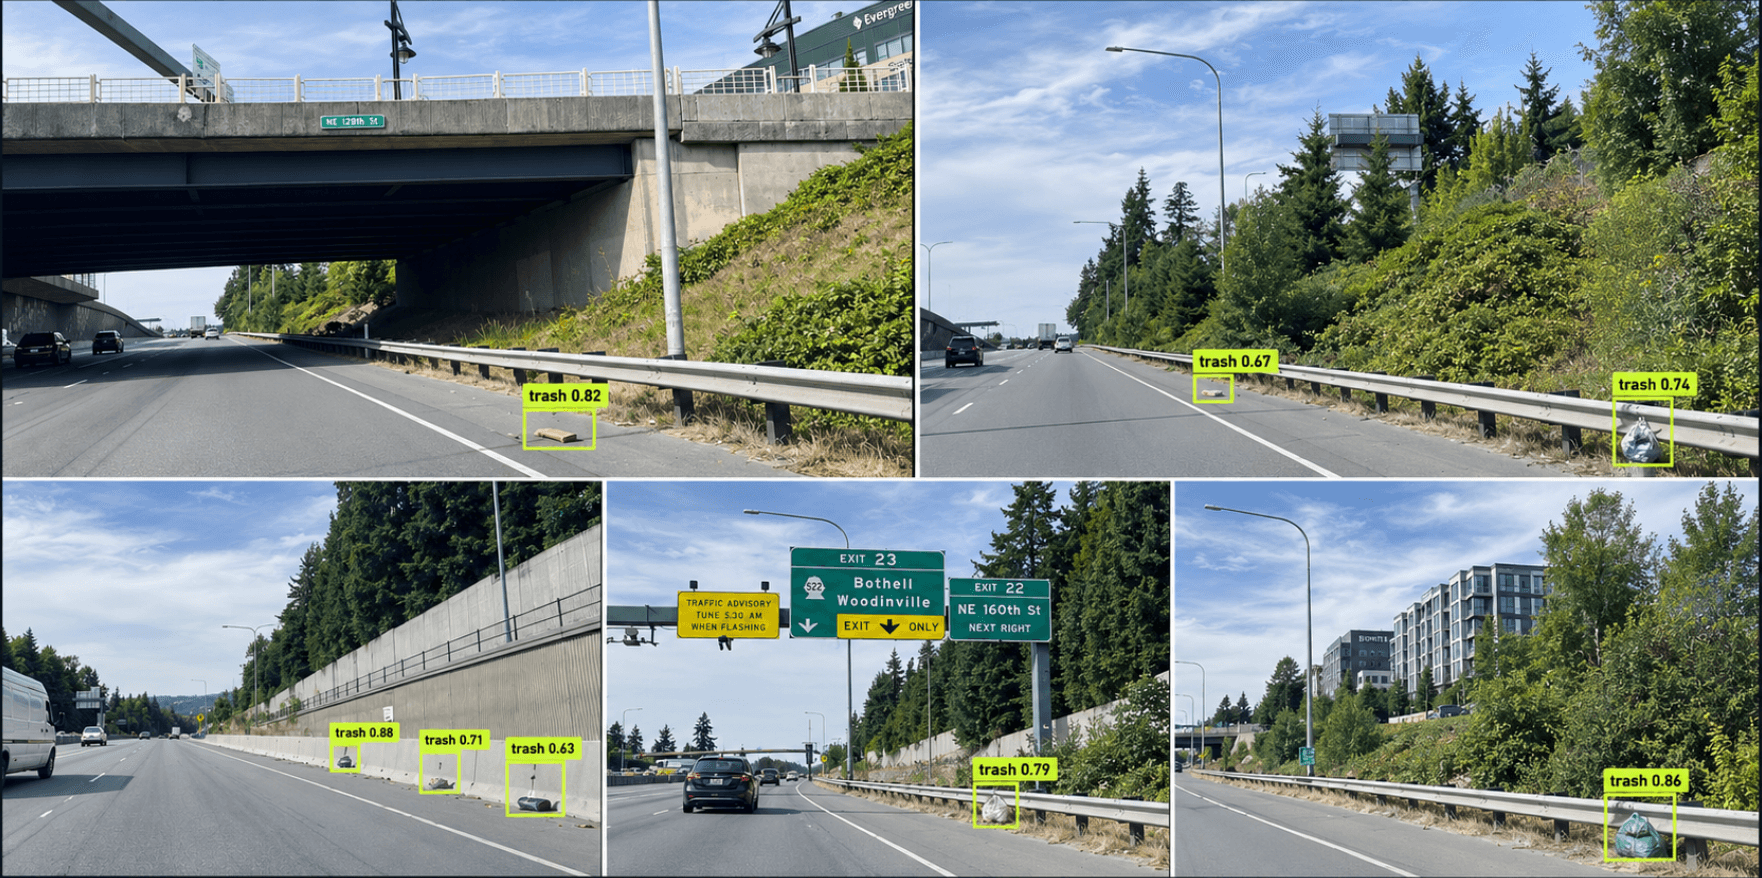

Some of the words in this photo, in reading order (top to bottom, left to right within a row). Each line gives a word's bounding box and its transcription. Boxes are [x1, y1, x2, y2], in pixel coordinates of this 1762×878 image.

[840, 554, 866, 564] EXIT
[875, 553, 897, 566] 23
[854, 577, 913, 590] Bothell
[975, 583, 997, 592] EXIT
[1006, 582, 1024, 594] 22
[686, 599, 723, 607] TRAFFIC
[837, 595, 931, 608] Woodinville
[958, 604, 976, 615] NE
[983, 604, 1021, 615] 160th
[1027, 604, 1041, 616] St
[691, 622, 717, 631] WHEN
[721, 623, 766, 631] FLASHING
[844, 621, 870, 631] EXIT
[909, 622, 939, 632] ONLY
[969, 623, 996, 632] NEXT
[1000, 624, 1032, 633] RIGHT
